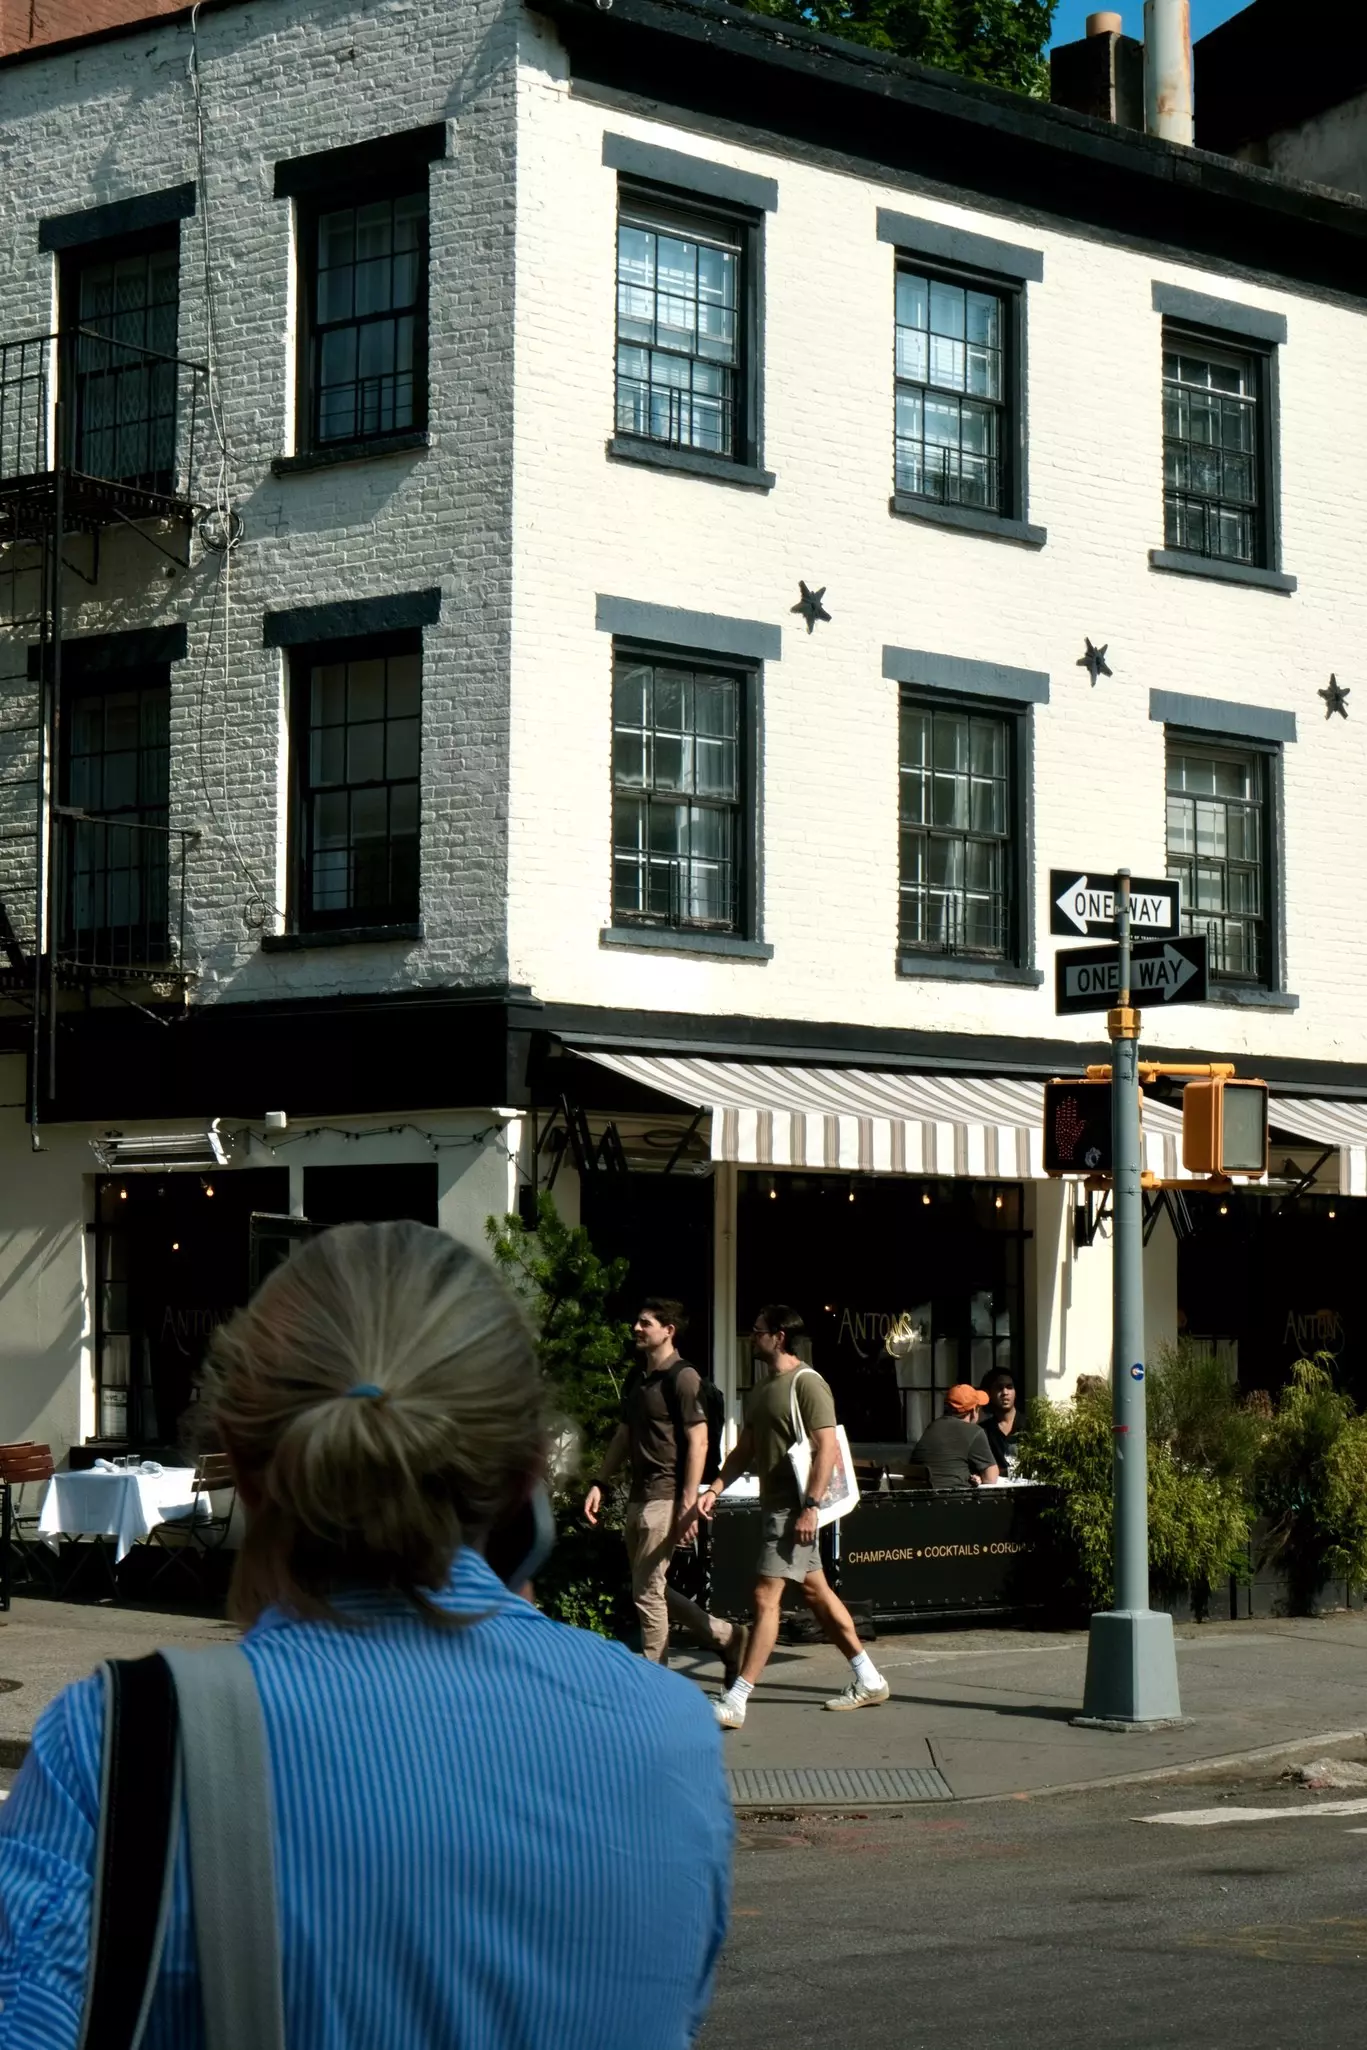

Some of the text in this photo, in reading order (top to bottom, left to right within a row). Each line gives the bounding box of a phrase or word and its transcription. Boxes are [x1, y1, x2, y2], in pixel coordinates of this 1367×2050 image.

[1075, 892, 1114, 918] ONE
[1078, 959, 1184, 992] ONE WAY
[848, 1547, 913, 1564] CHAMPAGNE
[924, 1543, 980, 1558] COCKTAILS
